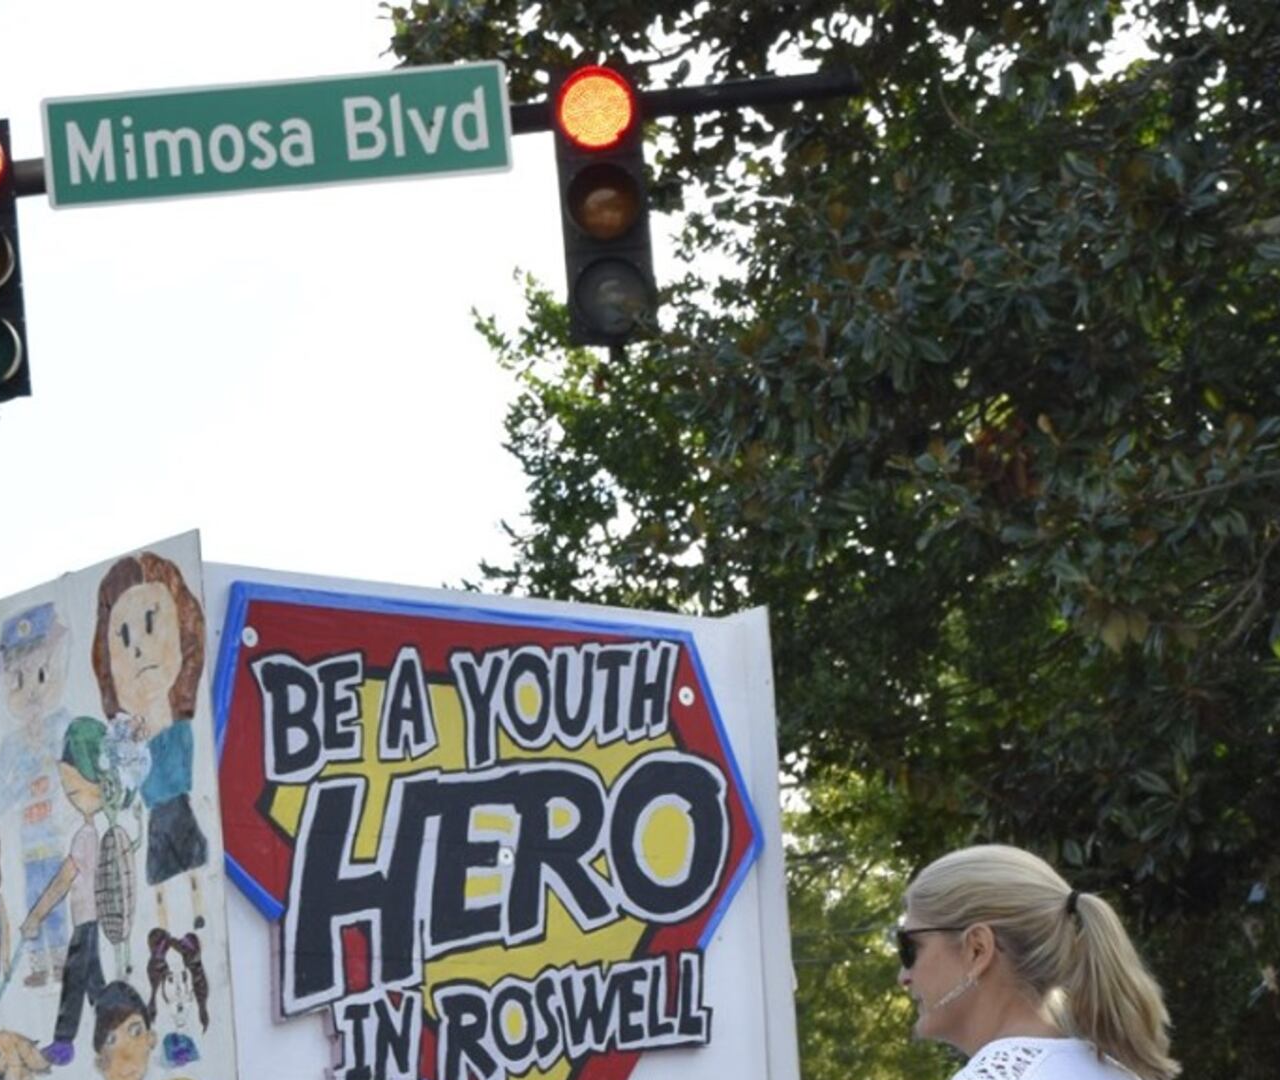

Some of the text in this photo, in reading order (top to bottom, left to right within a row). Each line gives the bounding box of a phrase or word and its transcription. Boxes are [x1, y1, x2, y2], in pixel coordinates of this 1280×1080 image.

[64, 84, 490, 185] Mimosa Blvd
[255, 641, 676, 780] BE A YOUTH
[286, 751, 729, 1010] HERO
